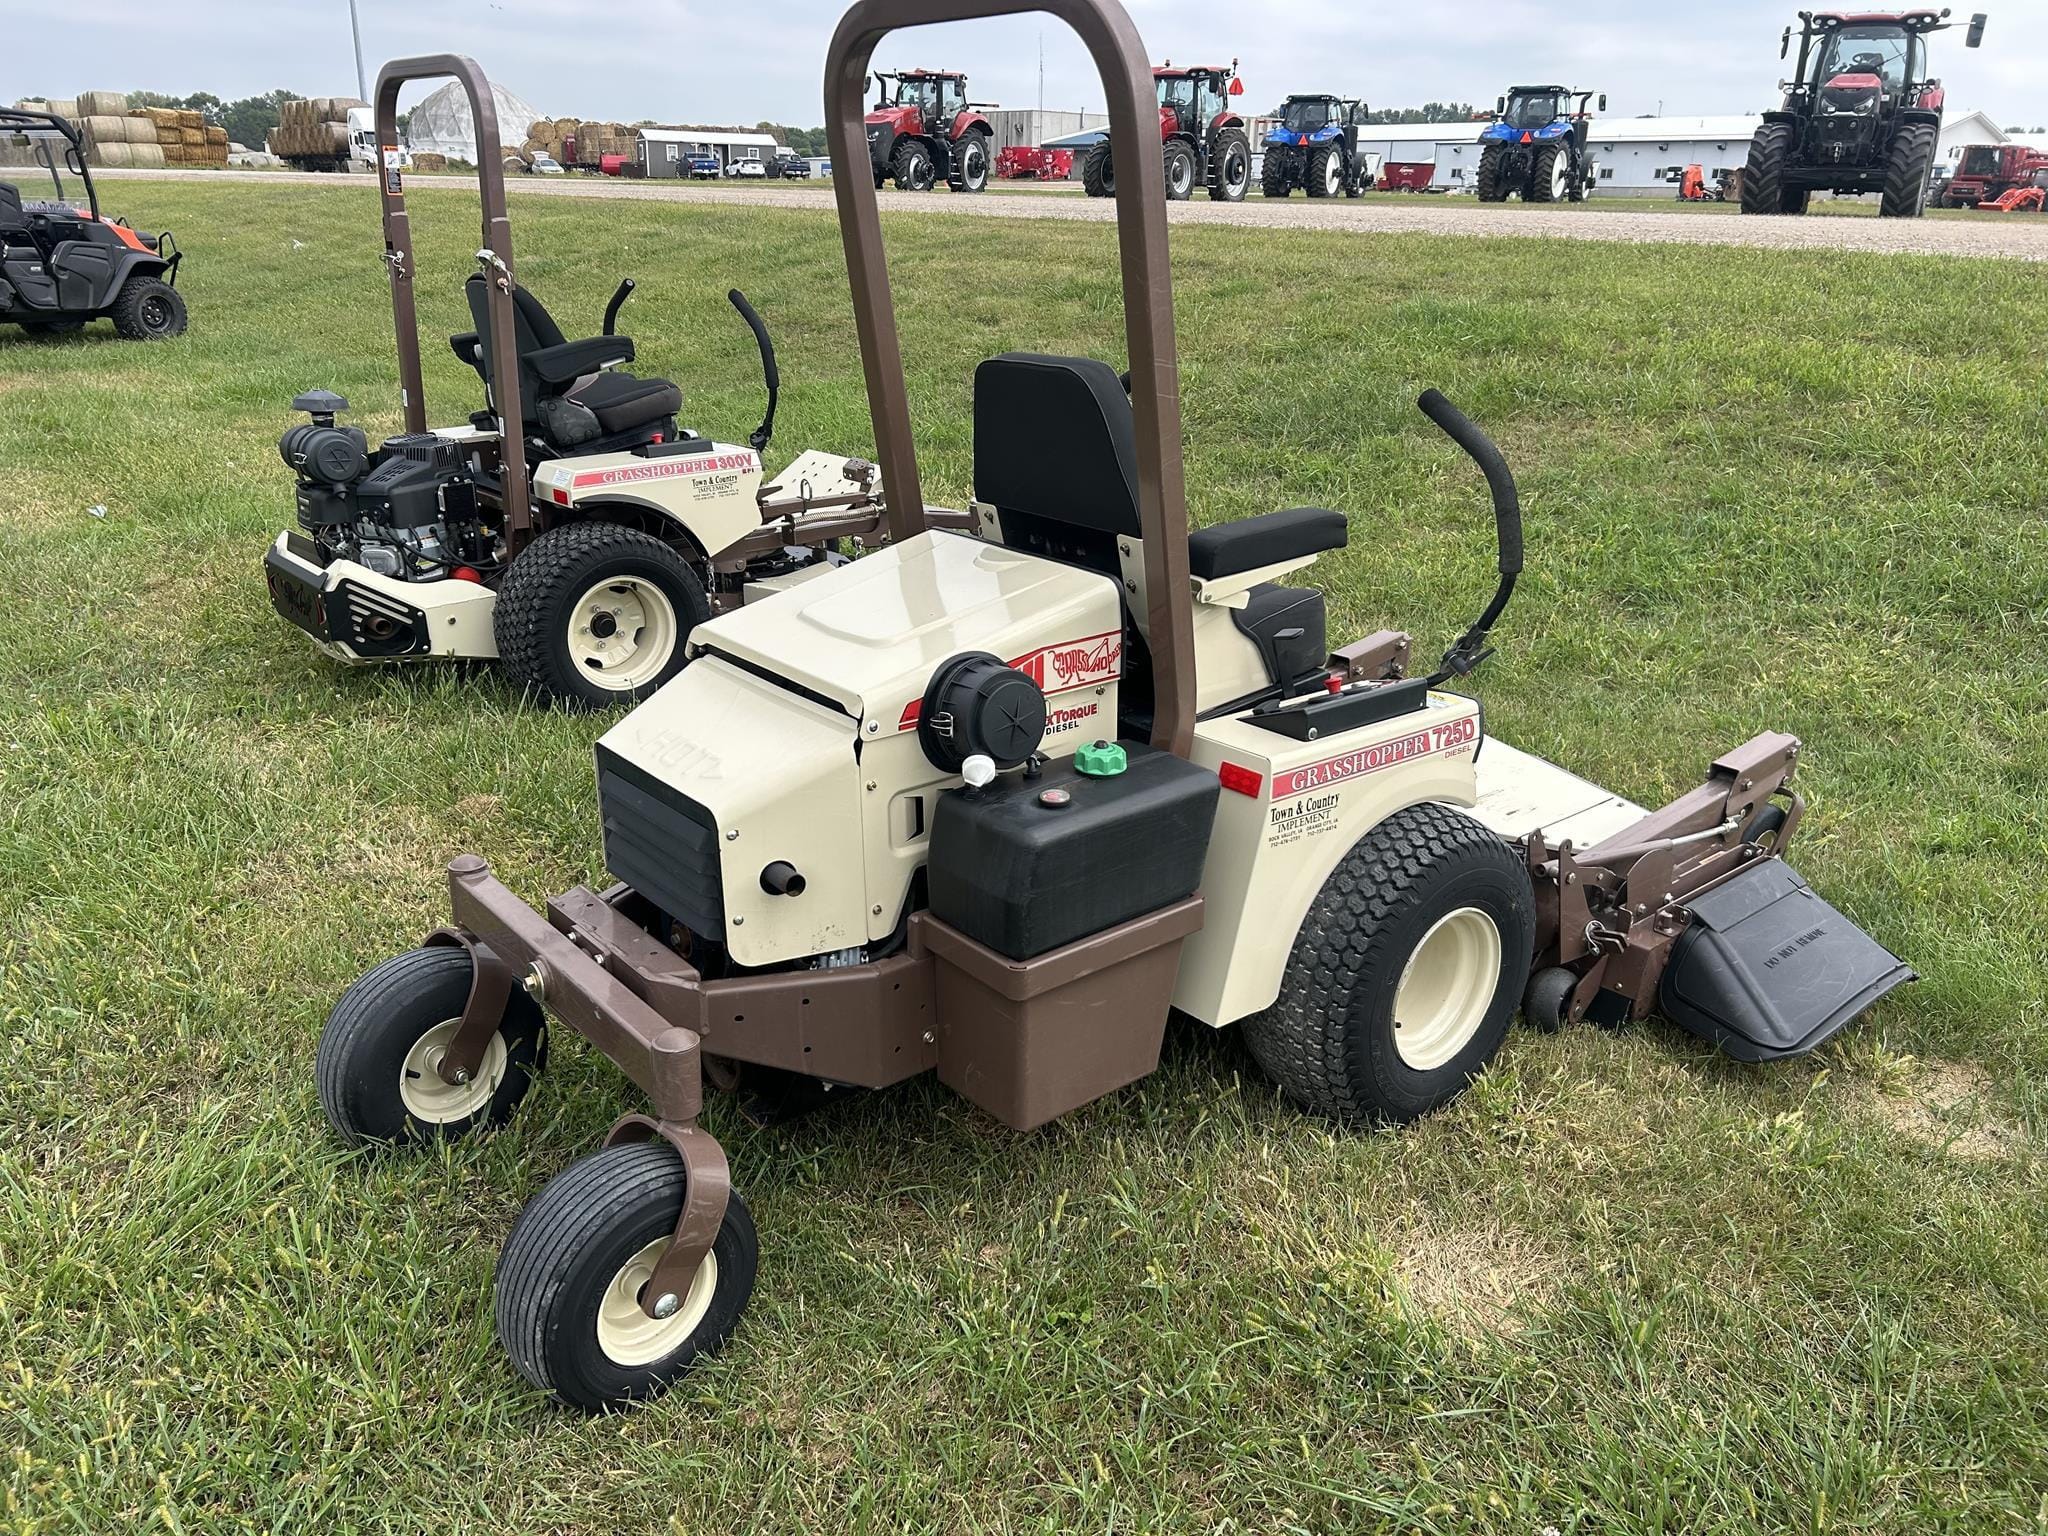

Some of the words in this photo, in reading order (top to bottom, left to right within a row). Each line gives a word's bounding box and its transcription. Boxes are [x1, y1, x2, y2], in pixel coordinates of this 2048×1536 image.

[603, 459, 711, 483] GRASSHOPPER
[717, 453, 752, 469] 300V
[692, 478, 707, 488] Town
[715, 474, 738, 484] Country
[1046, 703, 1098, 726] XTORQUE
[1046, 720, 1080, 735] DIESEL
[1291, 734, 1426, 791] GRASSHOPPER
[1432, 718, 1475, 749] 725D
[1444, 744, 1472, 760] DIESEL
[1271, 807, 1293, 822] Town
[1296, 800, 1304, 815] &
[1306, 793, 1340, 812] Country
[1277, 810, 1331, 833] IMPLEMENT
[1763, 956, 1780, 969] DO
[1777, 945, 1798, 959] NOT
